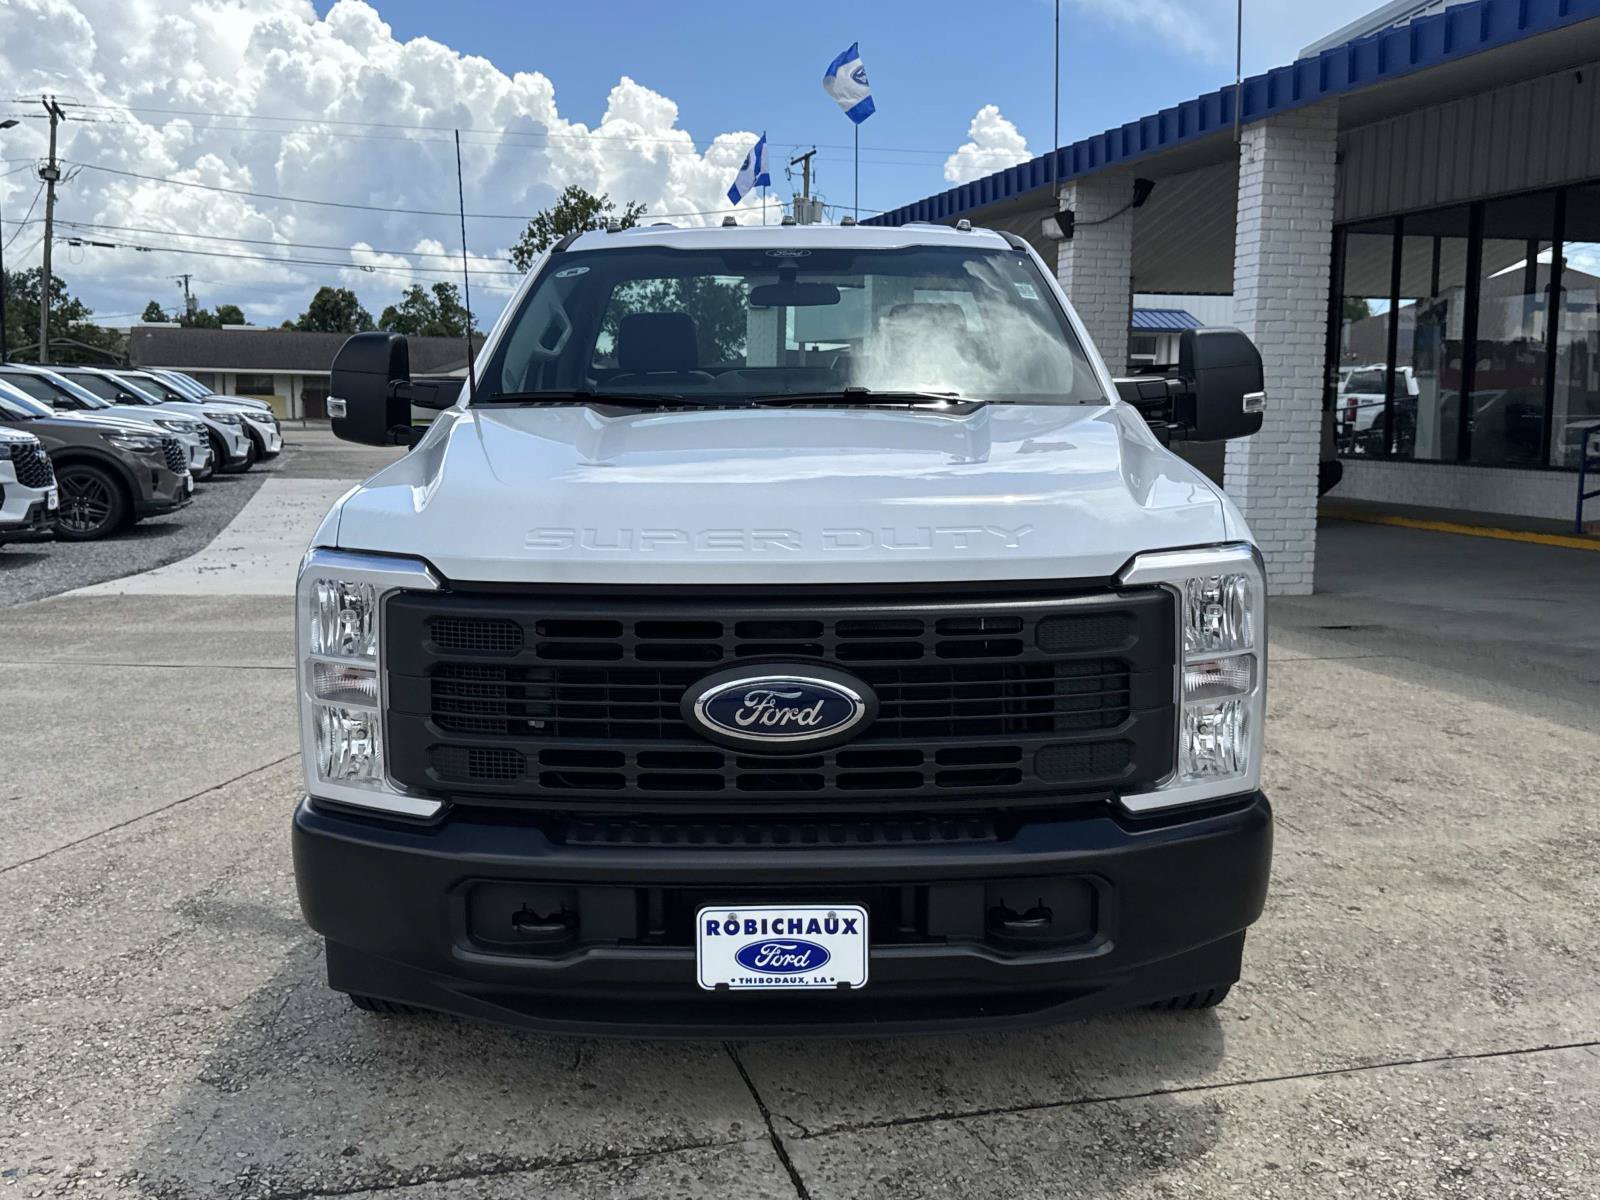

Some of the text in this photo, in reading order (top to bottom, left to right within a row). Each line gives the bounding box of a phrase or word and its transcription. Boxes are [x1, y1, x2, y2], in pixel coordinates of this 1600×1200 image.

[523, 524, 1035, 552] SUPER DUTY
[734, 689, 825, 726] Ford
[705, 917, 859, 936] ROBICHAUX
[754, 943, 812, 967] Ford
[738, 976, 828, 985] THIBODAUX, LA
